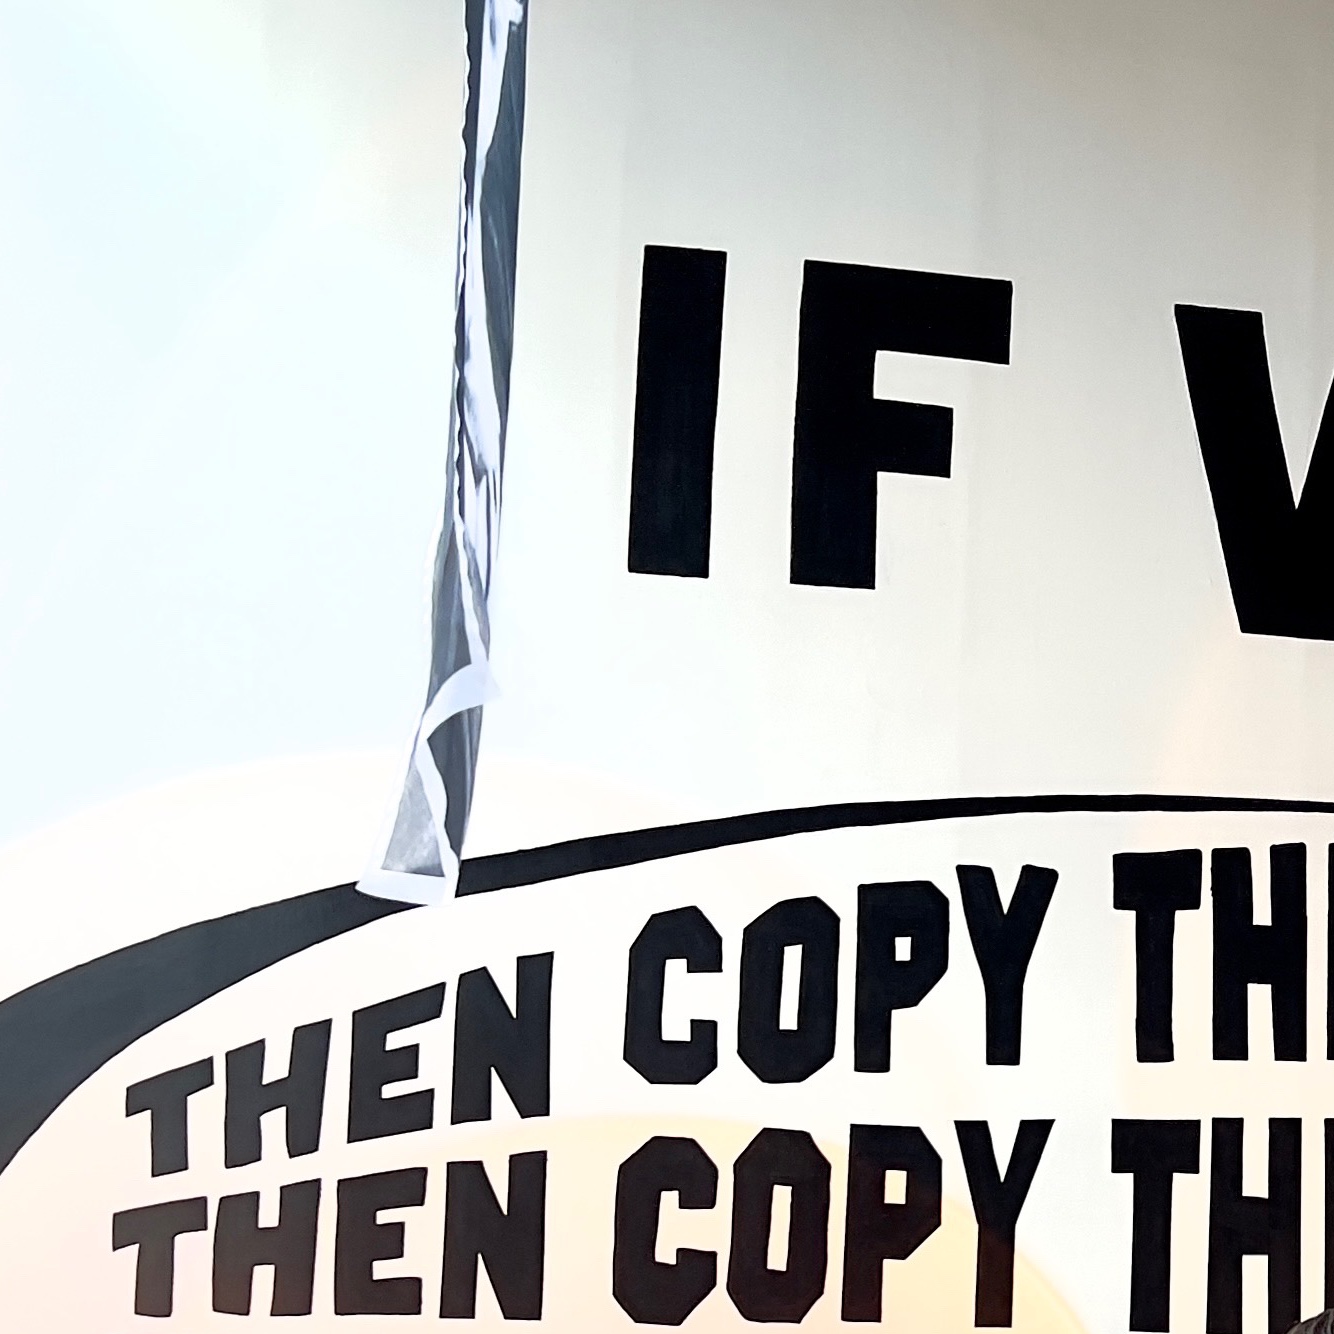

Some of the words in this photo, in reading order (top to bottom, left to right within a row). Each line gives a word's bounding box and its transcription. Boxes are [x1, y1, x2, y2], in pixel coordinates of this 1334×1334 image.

[628, 245, 1013, 590] IF
[126, 951, 554, 1177] THEN
[623, 863, 1058, 1085] COPY
[112, 1151, 547, 1320] THEN
[613, 1119, 1055, 1328] COPY
